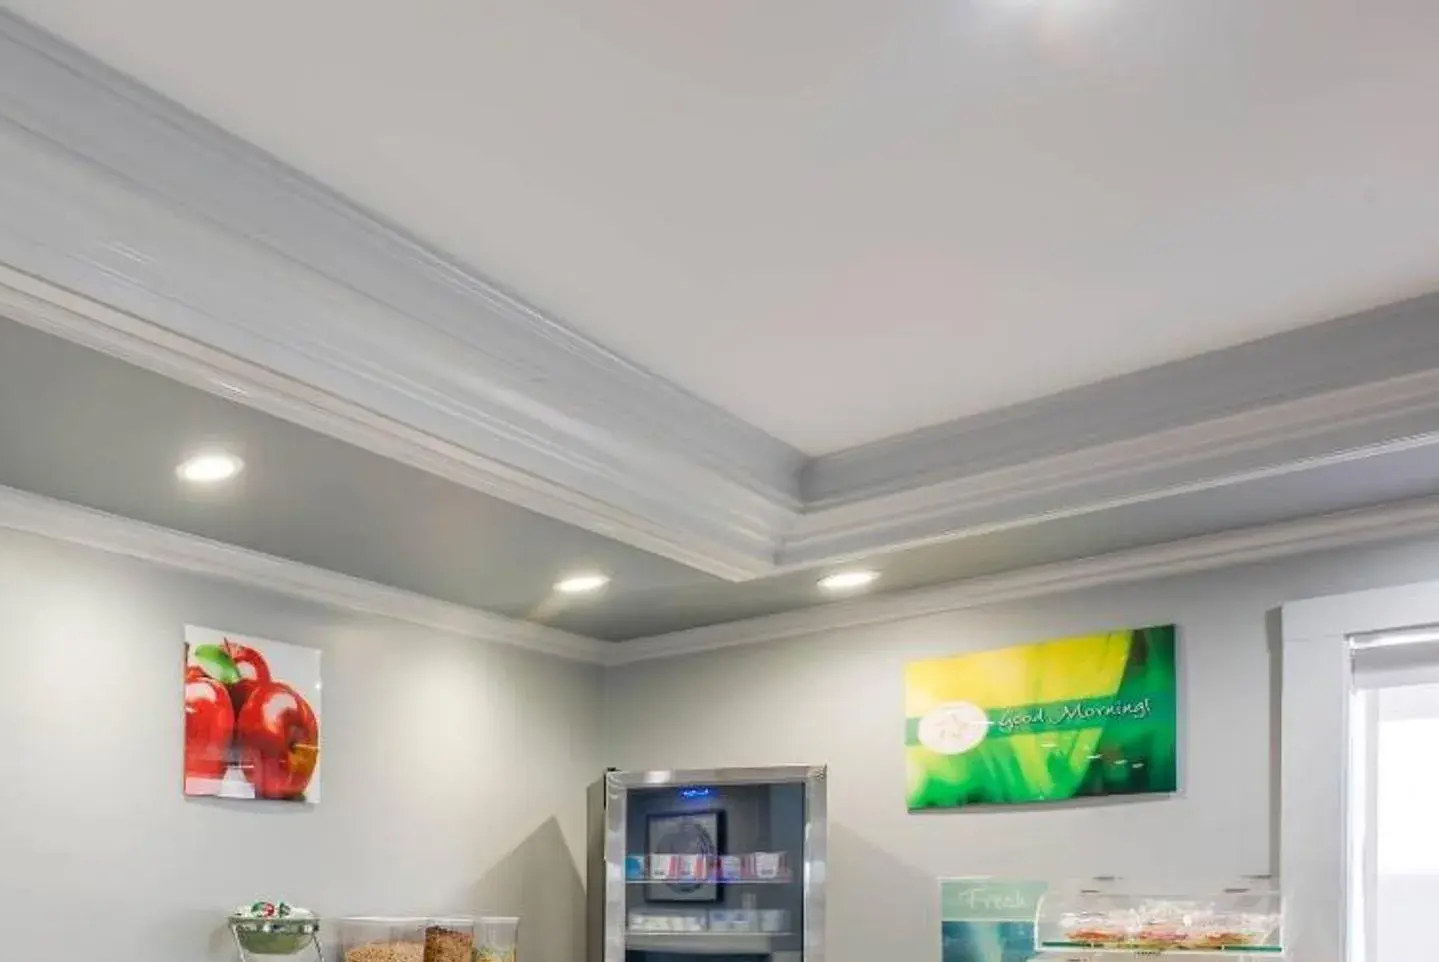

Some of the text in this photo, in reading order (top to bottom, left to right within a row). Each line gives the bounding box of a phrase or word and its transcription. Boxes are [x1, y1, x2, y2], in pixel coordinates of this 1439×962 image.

[998, 697, 1151, 733] Good Morning!
[958, 887, 1028, 911] Fresh
